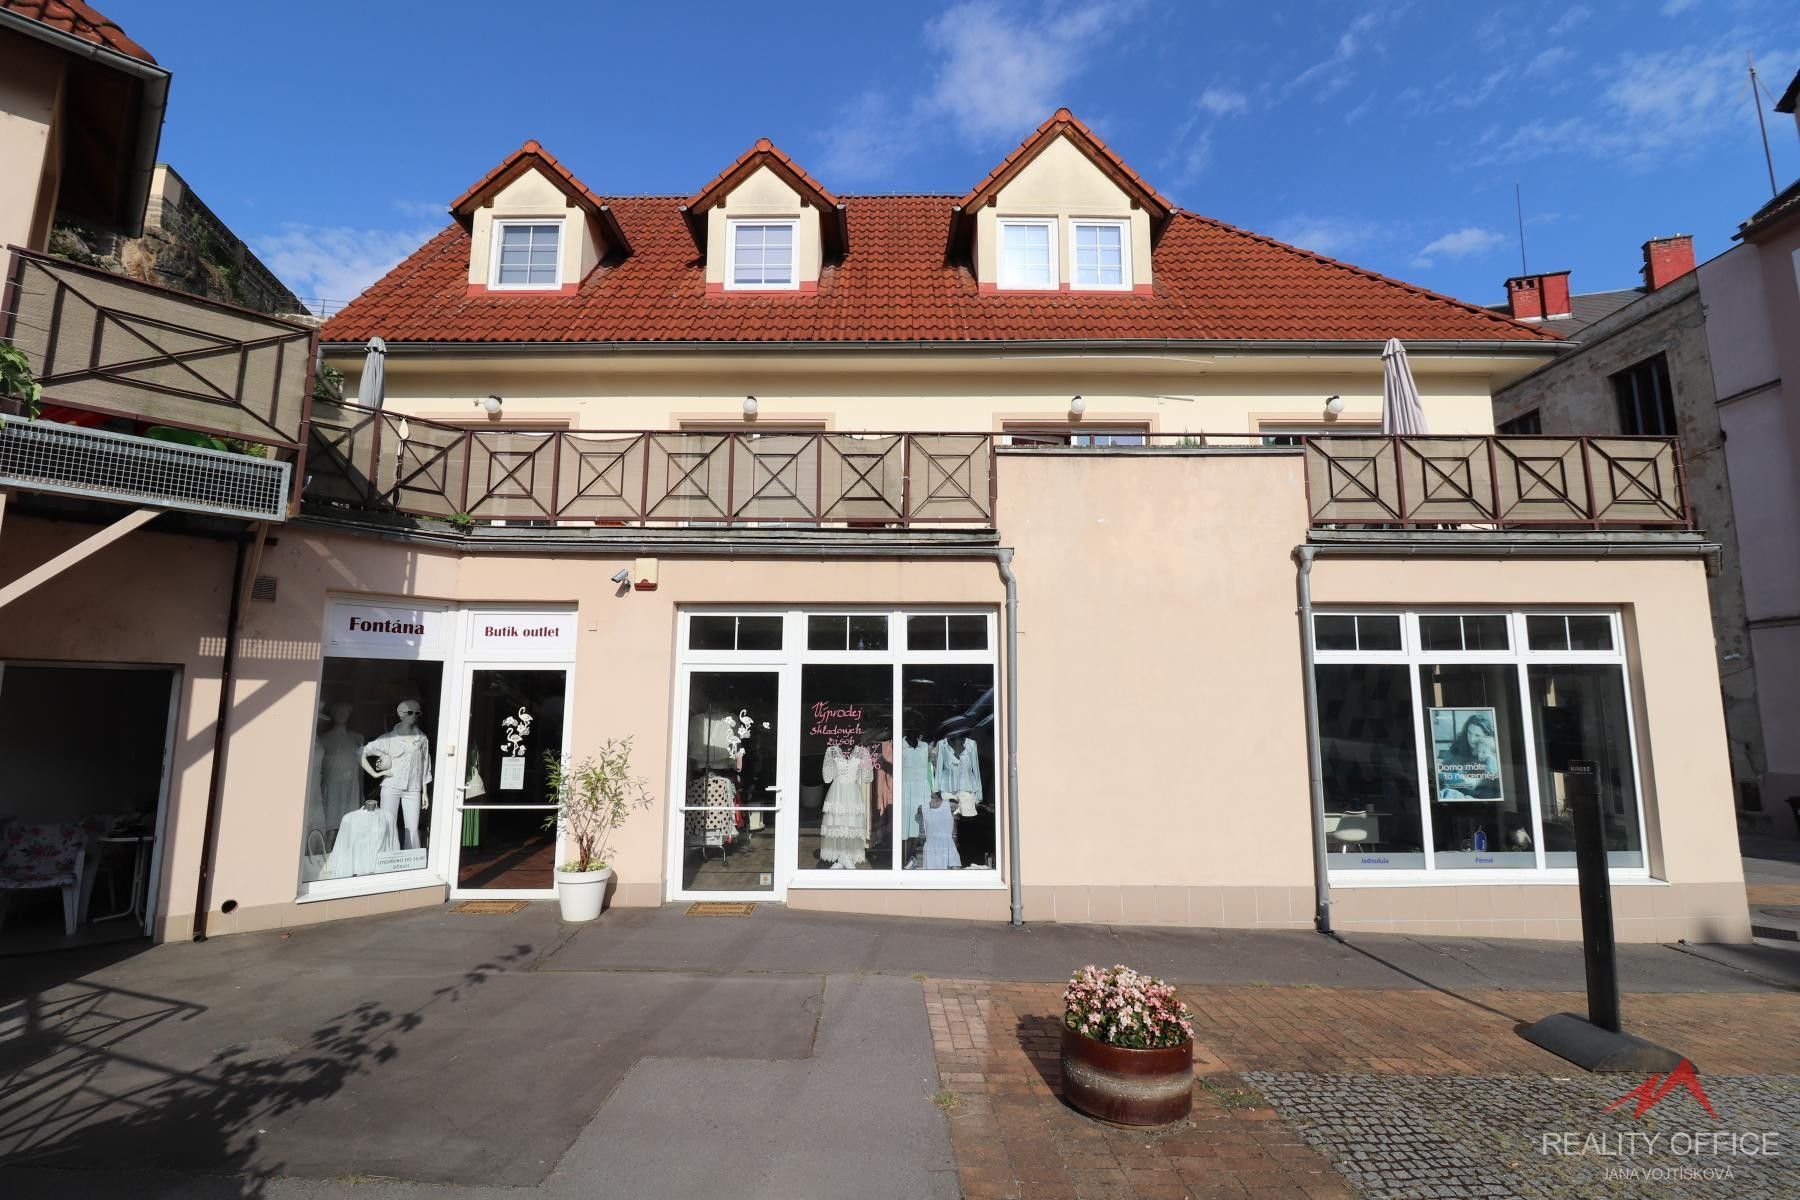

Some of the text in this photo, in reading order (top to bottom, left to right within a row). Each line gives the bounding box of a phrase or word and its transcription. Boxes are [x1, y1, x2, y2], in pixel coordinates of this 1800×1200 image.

[349, 616, 425, 635] Fontána
[484, 626, 560, 637] Butik outlet
[810, 701, 862, 723] Výprodej
[1438, 763, 1463, 771] Doma
